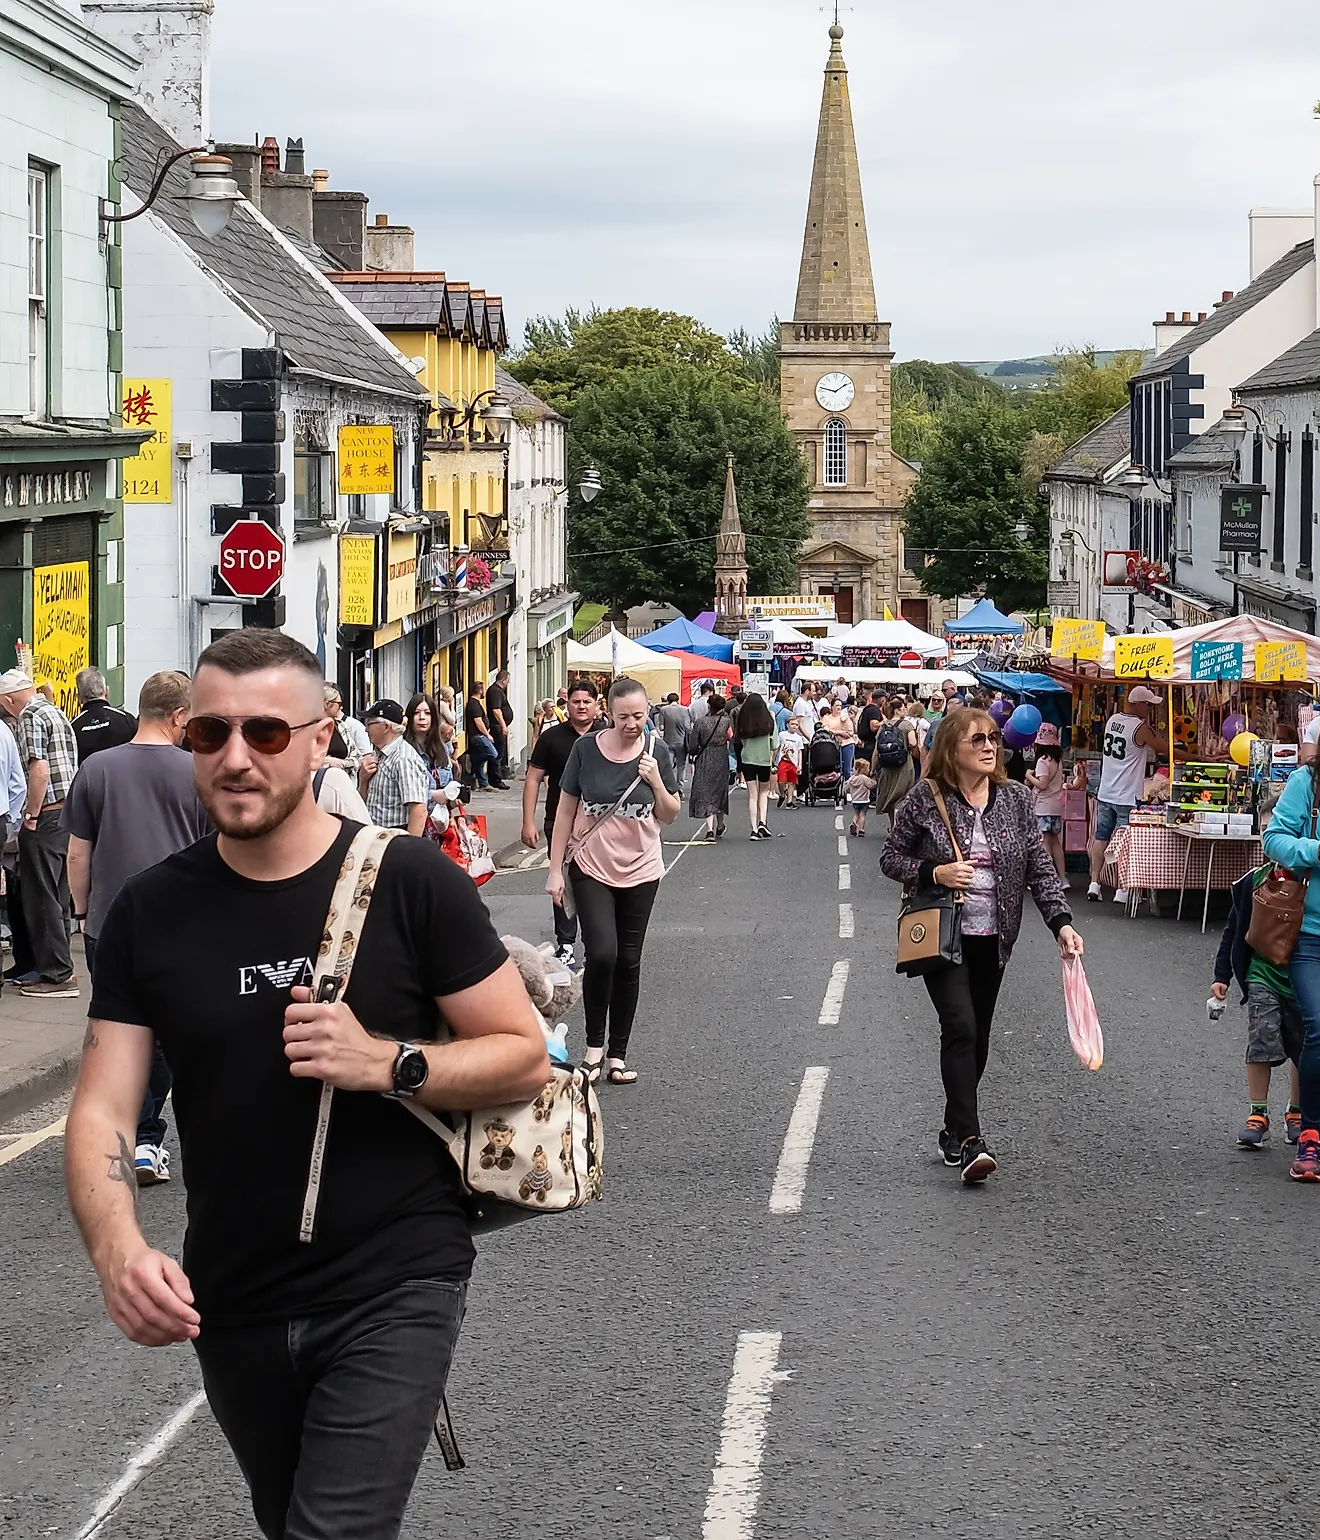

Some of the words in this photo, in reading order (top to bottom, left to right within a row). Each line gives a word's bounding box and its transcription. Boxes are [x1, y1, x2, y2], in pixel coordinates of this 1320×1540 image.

[356, 427, 375, 435] NEW
[341, 437, 390, 447] CANTON
[347, 449, 386, 459] HOUSE
[341, 484, 355, 493] 028
[375, 484, 392, 493] 3124
[1223, 521, 1259, 530] McMullan
[1222, 529, 1259, 540] Pharmacy
[346, 539, 371, 548] NEW
[223, 548, 281, 570] STOP
[471, 551, 508, 559] GUINNESS
[346, 571, 368, 579] TAKE
[39, 570, 84, 605] YELLAMAN
[348, 596, 365, 604] 028
[345, 605, 368, 614] 2076
[763, 607, 819, 616] PAINTBALL
[345, 614, 367, 623] 3124
[1062, 623, 1095, 637] YELLAMAN
[1130, 642, 1157, 657] FRESH
[1199, 643, 1235, 660] HONEYCOMB
[1264, 643, 1296, 660] YELLAMAN
[1217, 651, 1234, 663] HERE
[1282, 651, 1298, 663] HERE
[1120, 655, 1165, 674] DULSE
[1195, 668, 1211, 679] BEST
[1214, 664, 1221, 673] IN
[1223, 659, 1238, 670] FAIR
[1279, 664, 1286, 672] IN
[1288, 659, 1303, 669] FAIR
[1104, 733, 1126, 760] 33
[238, 965, 258, 996] E
